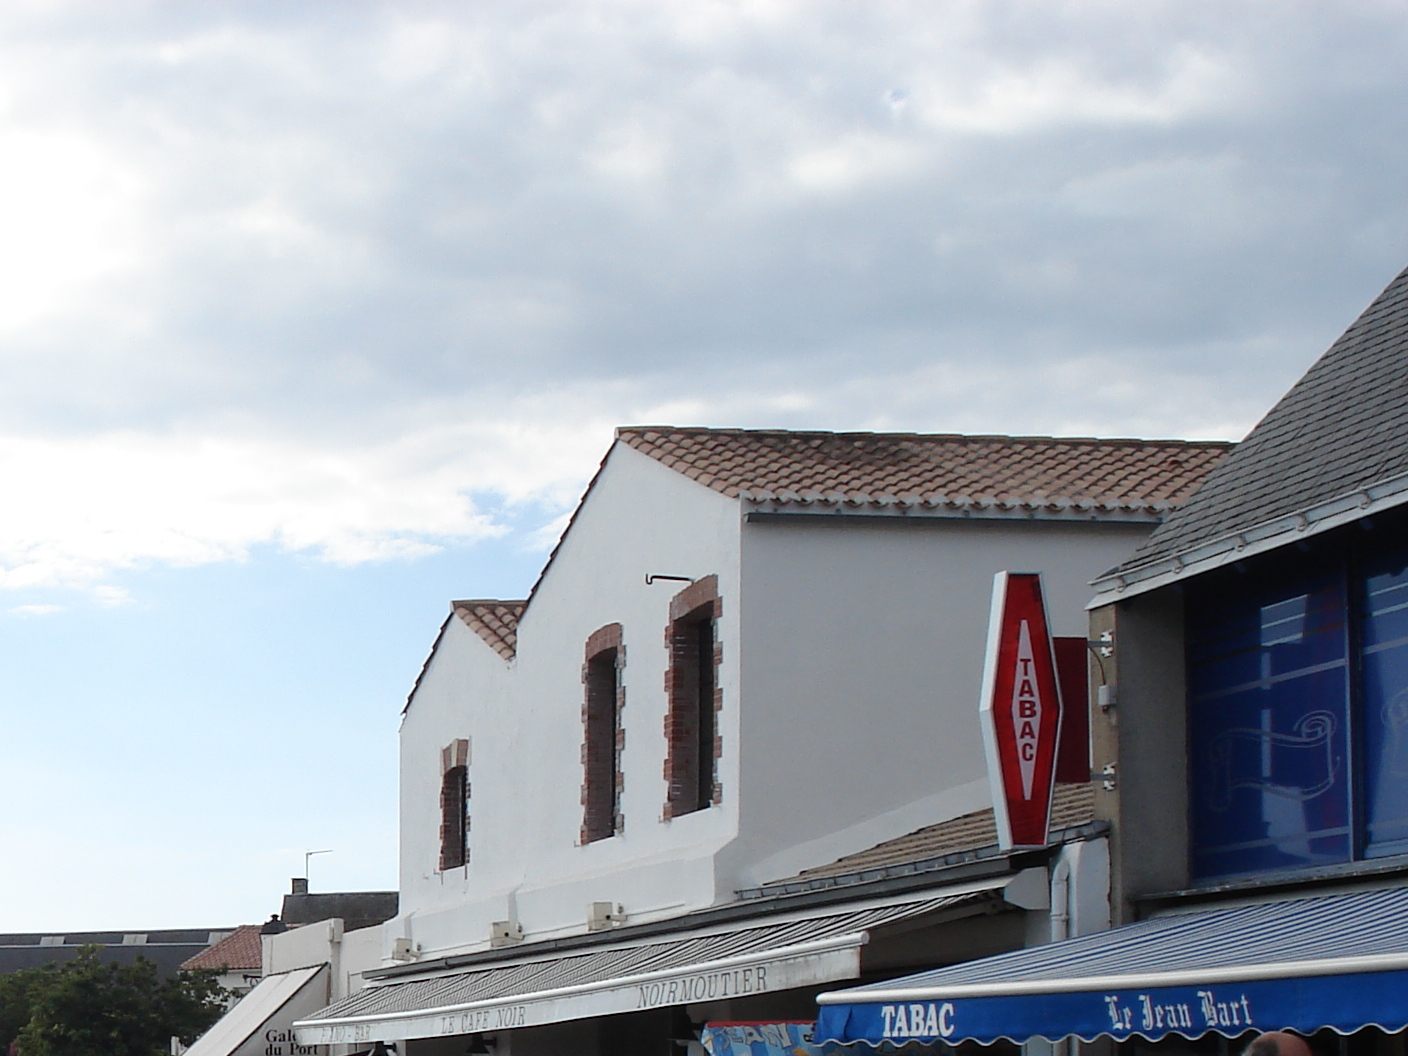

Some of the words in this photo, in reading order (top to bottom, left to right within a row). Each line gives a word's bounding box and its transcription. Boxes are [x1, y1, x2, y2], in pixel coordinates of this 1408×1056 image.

[1018, 658, 1037, 762] TABAC
[637, 966, 767, 1009] NOIRMOUTIER
[441, 1015, 455, 1035] LE
[495, 1006, 526, 1028] NOIR
[881, 1002, 955, 1038] TABAC
[1104, 995, 1132, 1031] Le
[1138, 994, 1192, 1031] Jean
[1196, 990, 1253, 1027] Bart
[265, 1043, 282, 1056] du
[289, 1043, 318, 1056] Port
